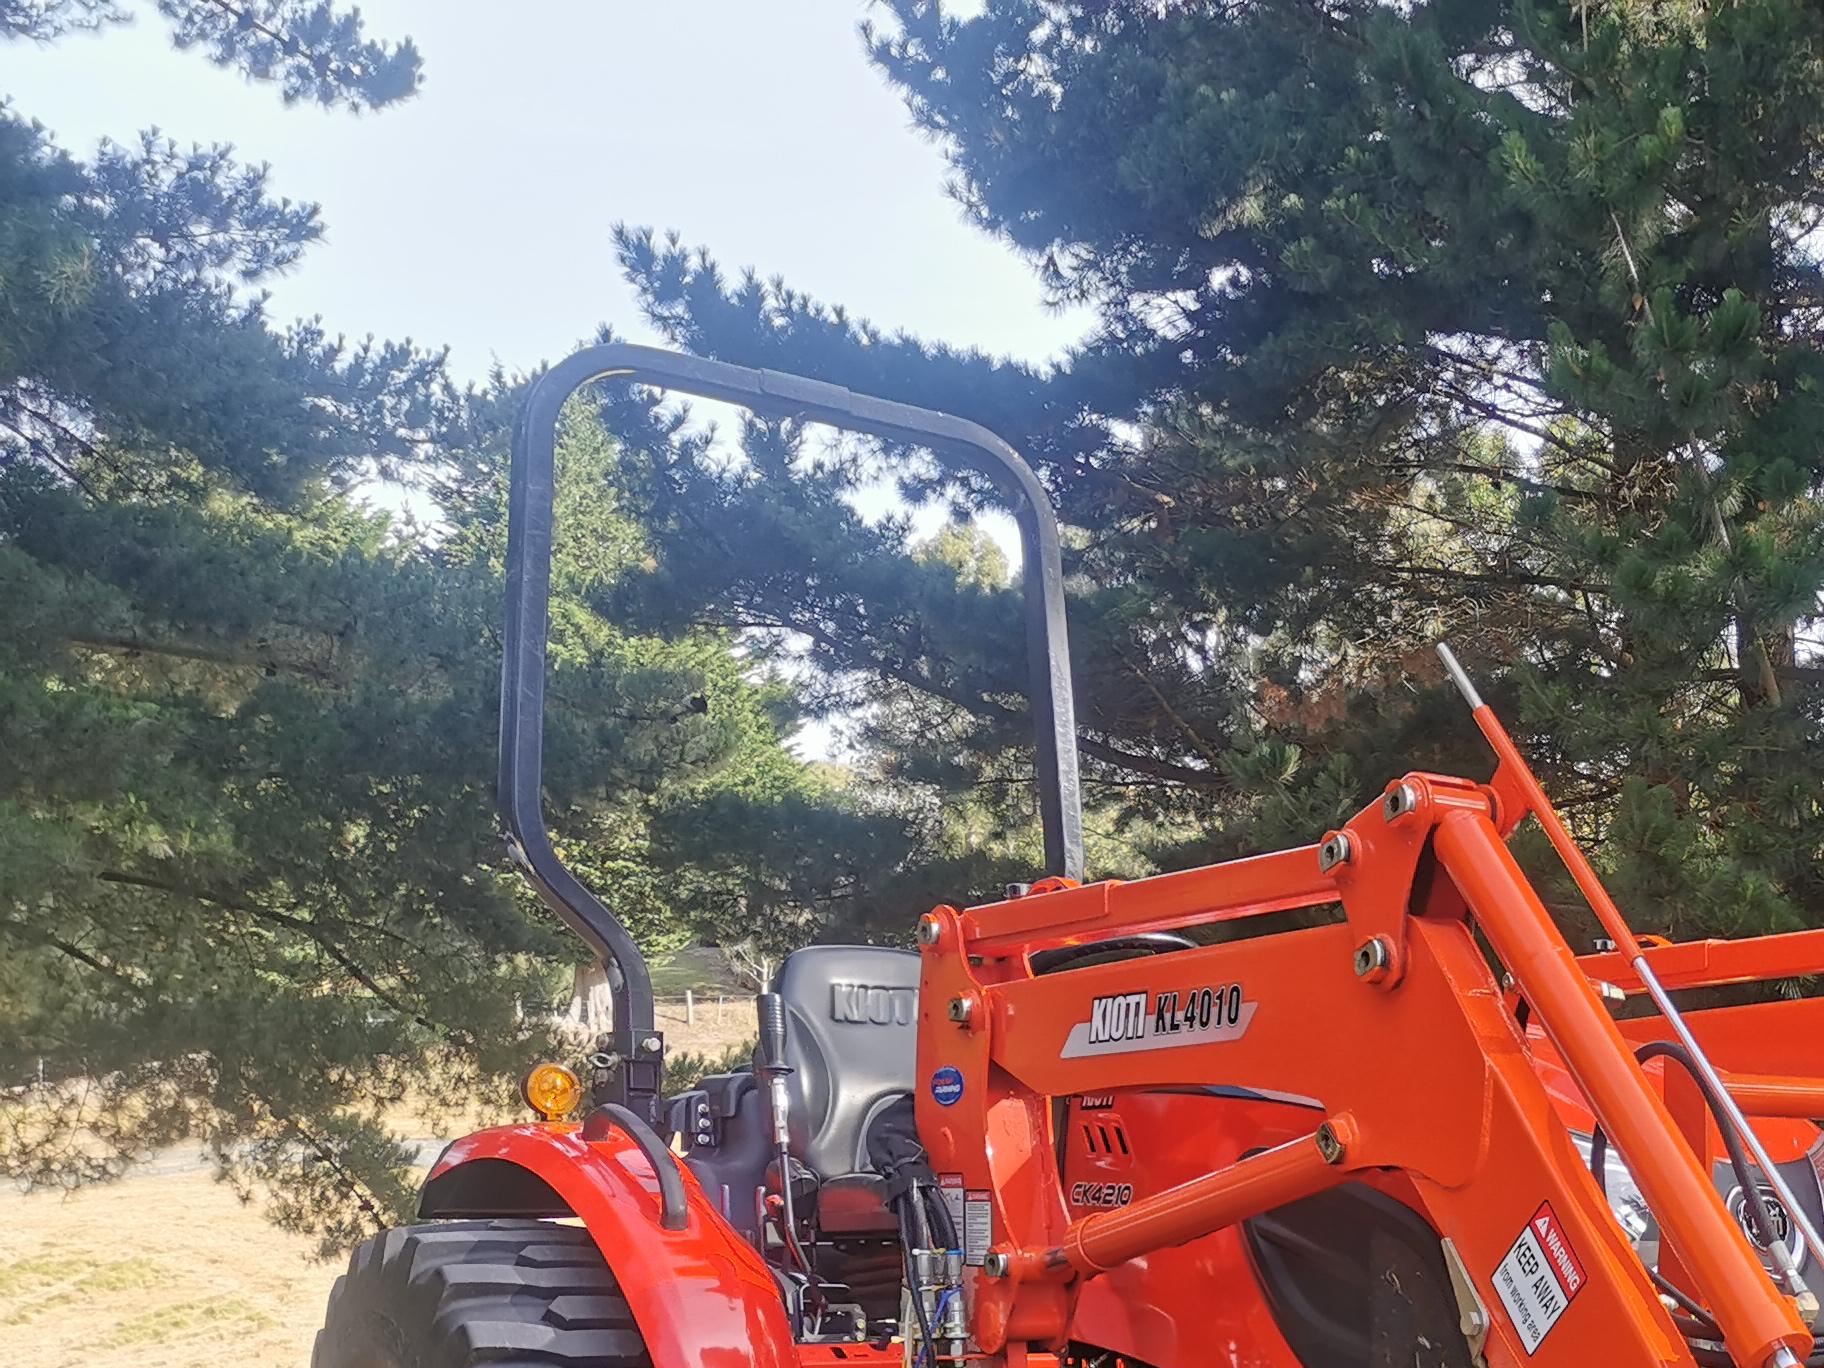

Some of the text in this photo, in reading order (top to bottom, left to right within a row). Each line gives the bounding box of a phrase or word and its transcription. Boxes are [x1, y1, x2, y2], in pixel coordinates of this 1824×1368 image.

[1089, 992, 1148, 1043] KIOTI
[1071, 1181, 1133, 1207] CK4210
[1514, 1236, 1561, 1320] KEEP AWAY
[1546, 1228, 1580, 1292] WARNING
[1500, 1262, 1541, 1343] from working area
